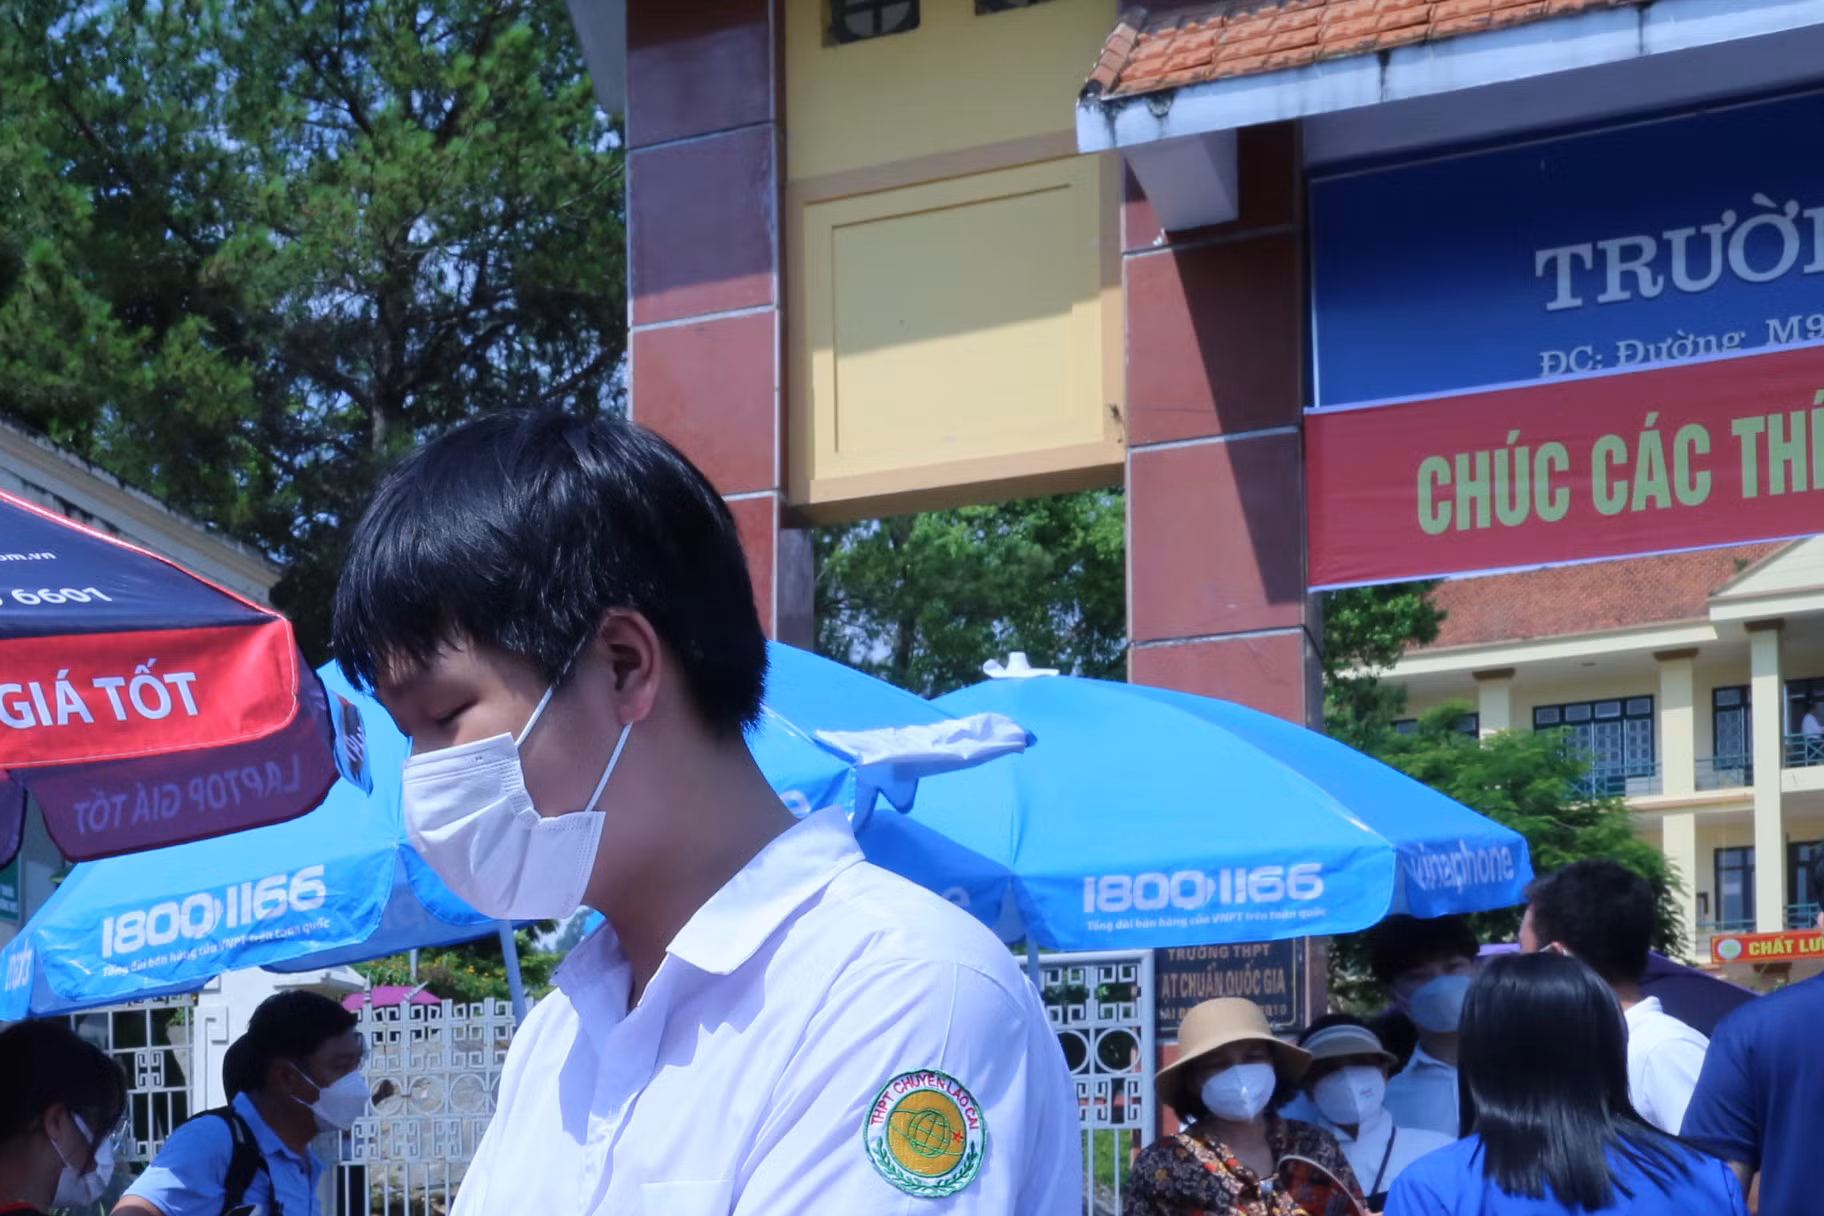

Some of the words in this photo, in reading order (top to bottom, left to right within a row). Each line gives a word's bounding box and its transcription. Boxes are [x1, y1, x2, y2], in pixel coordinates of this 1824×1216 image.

[1535, 192, 1824, 311] TRƯỜ
[1616, 329, 1746, 367] Đường
[1417, 429, 1570, 535] CHÚC
[1591, 412, 1712, 516] CÁC
[12, 587, 113, 606] 6601
[92, 657, 198, 721] TỐT
[870, 1090, 894, 1125] THPT
